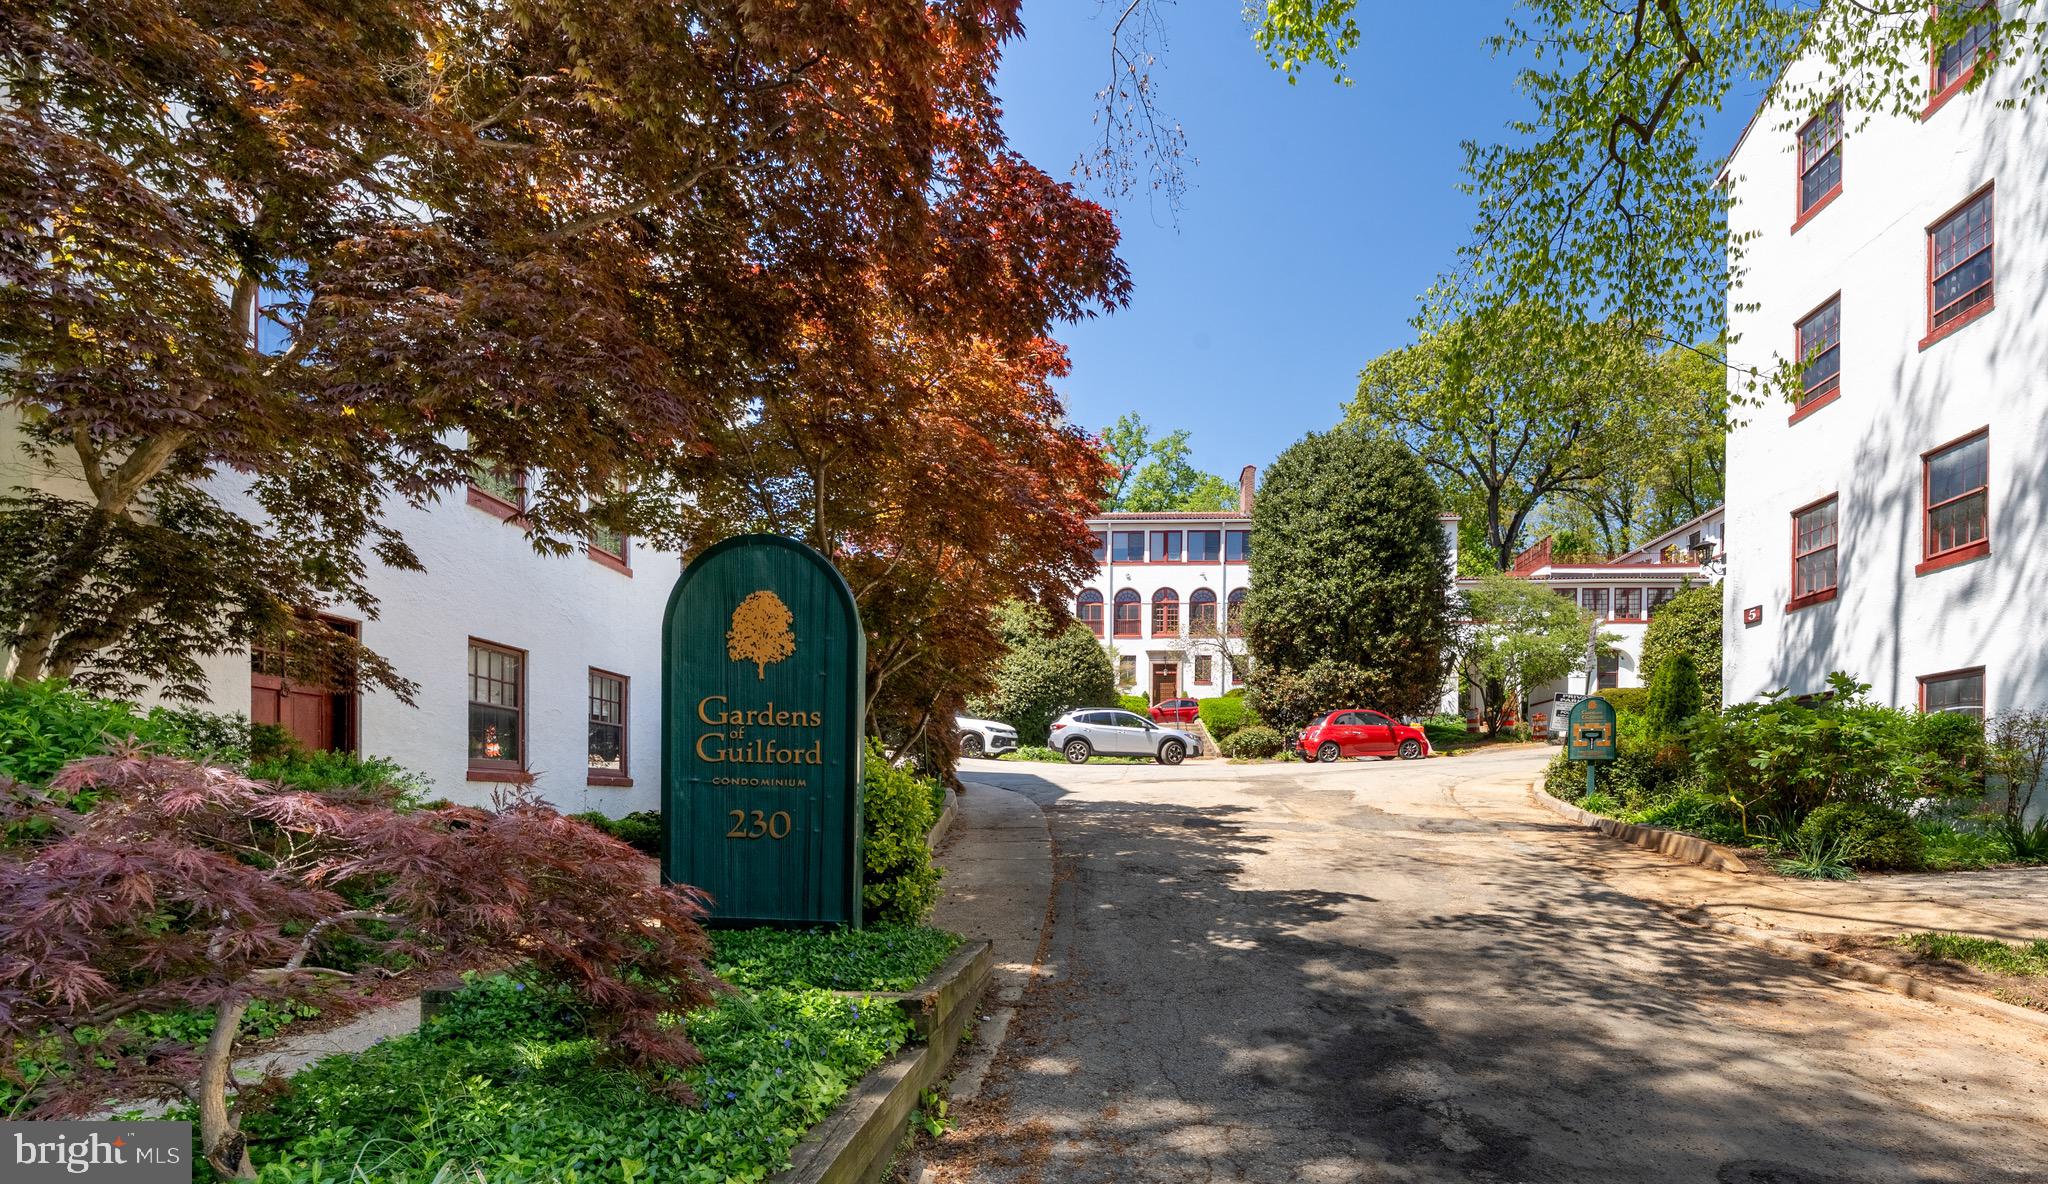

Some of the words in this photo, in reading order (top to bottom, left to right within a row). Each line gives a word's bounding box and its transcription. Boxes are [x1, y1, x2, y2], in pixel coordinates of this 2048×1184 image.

[1748, 609, 1756, 620] 5
[698, 695, 821, 727] Gardens
[729, 726, 745, 739] of
[696, 733, 822, 764] Guilford
[712, 777, 807, 787] CONDOMINIUM
[726, 809, 791, 839] 230
